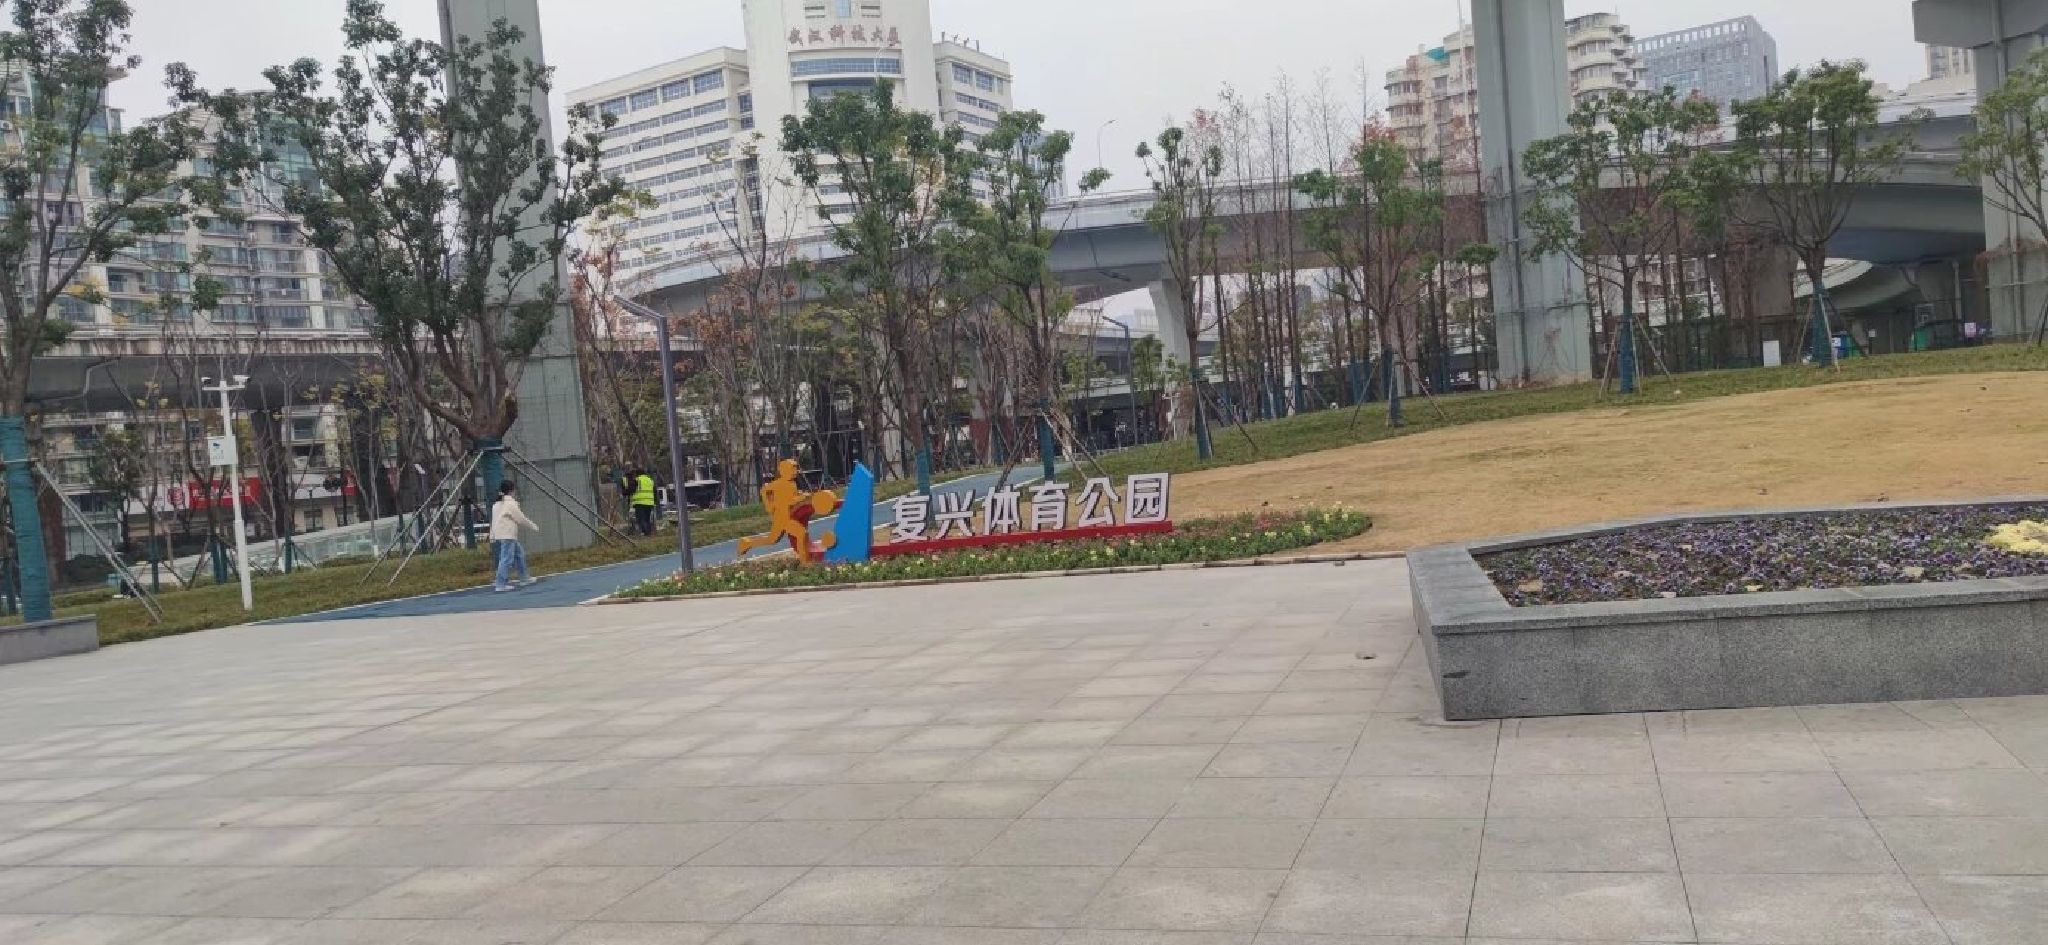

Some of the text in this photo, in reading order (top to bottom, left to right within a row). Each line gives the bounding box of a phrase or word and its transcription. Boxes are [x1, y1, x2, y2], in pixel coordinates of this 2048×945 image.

[889, 472, 1169, 544] 复兴体育公园
